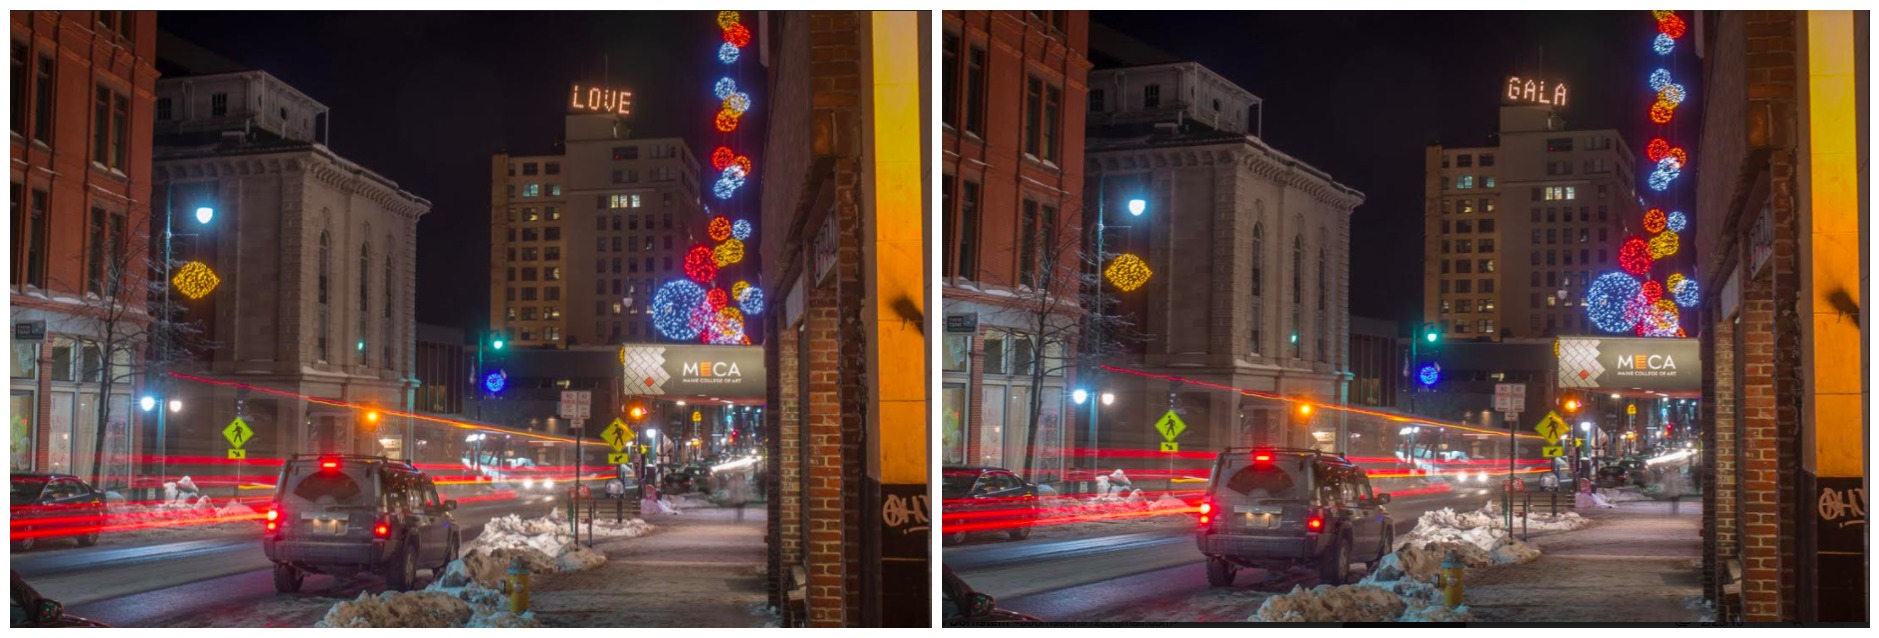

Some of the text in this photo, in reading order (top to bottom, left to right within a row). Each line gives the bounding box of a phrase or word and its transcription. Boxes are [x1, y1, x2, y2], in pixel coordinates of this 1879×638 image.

[573, 85, 631, 114] LOVE
[1508, 76, 1567, 106] GALA
[682, 361, 741, 376] MECA
[1617, 354, 1676, 369] MECA
